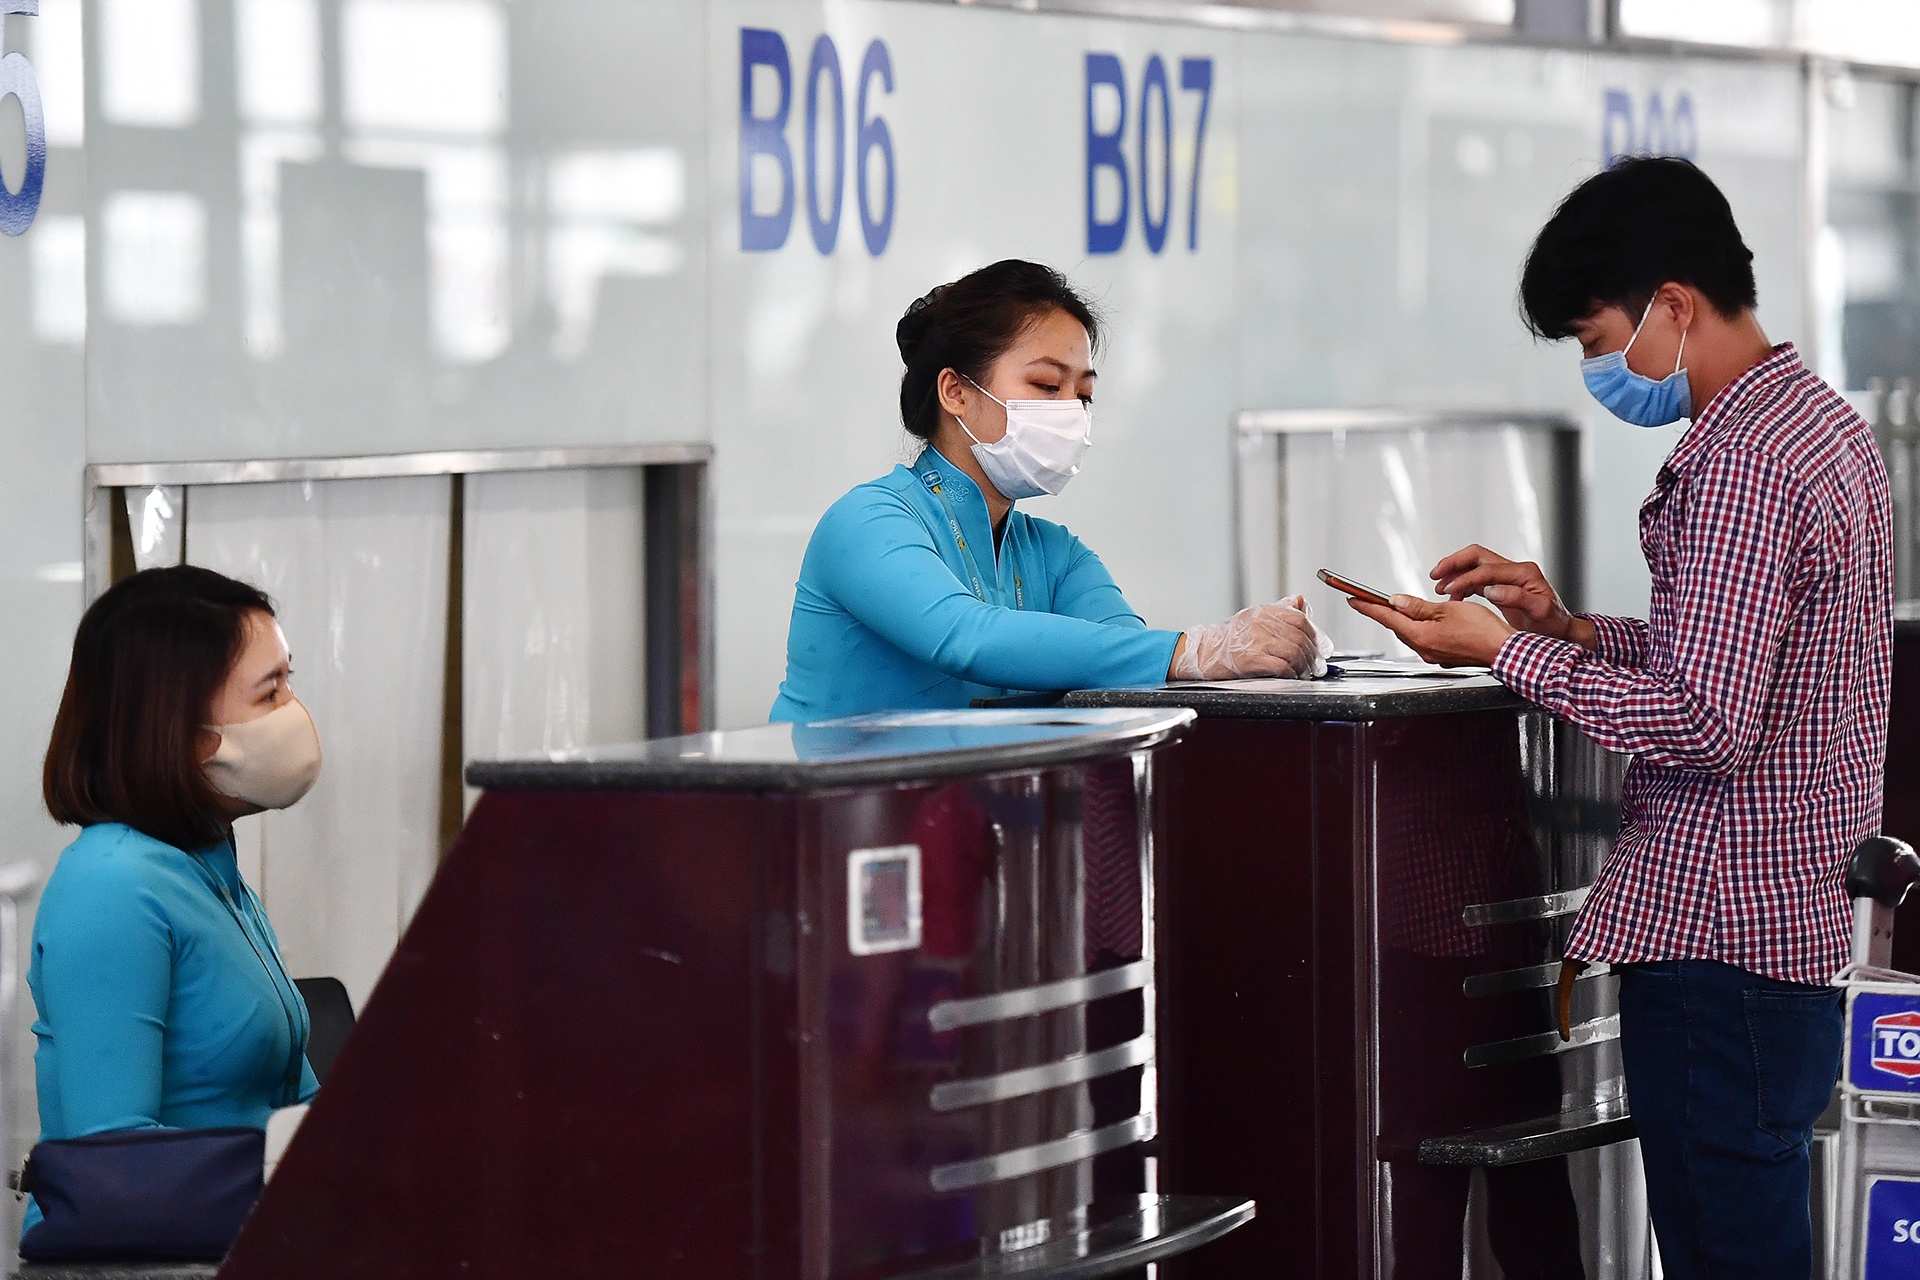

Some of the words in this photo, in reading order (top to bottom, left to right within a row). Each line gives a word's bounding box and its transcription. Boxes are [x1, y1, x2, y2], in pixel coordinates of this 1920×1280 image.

[738, 27, 897, 257] B06
[1085, 51, 1213, 255] B07
[1879, 1030, 1920, 1058] TO
